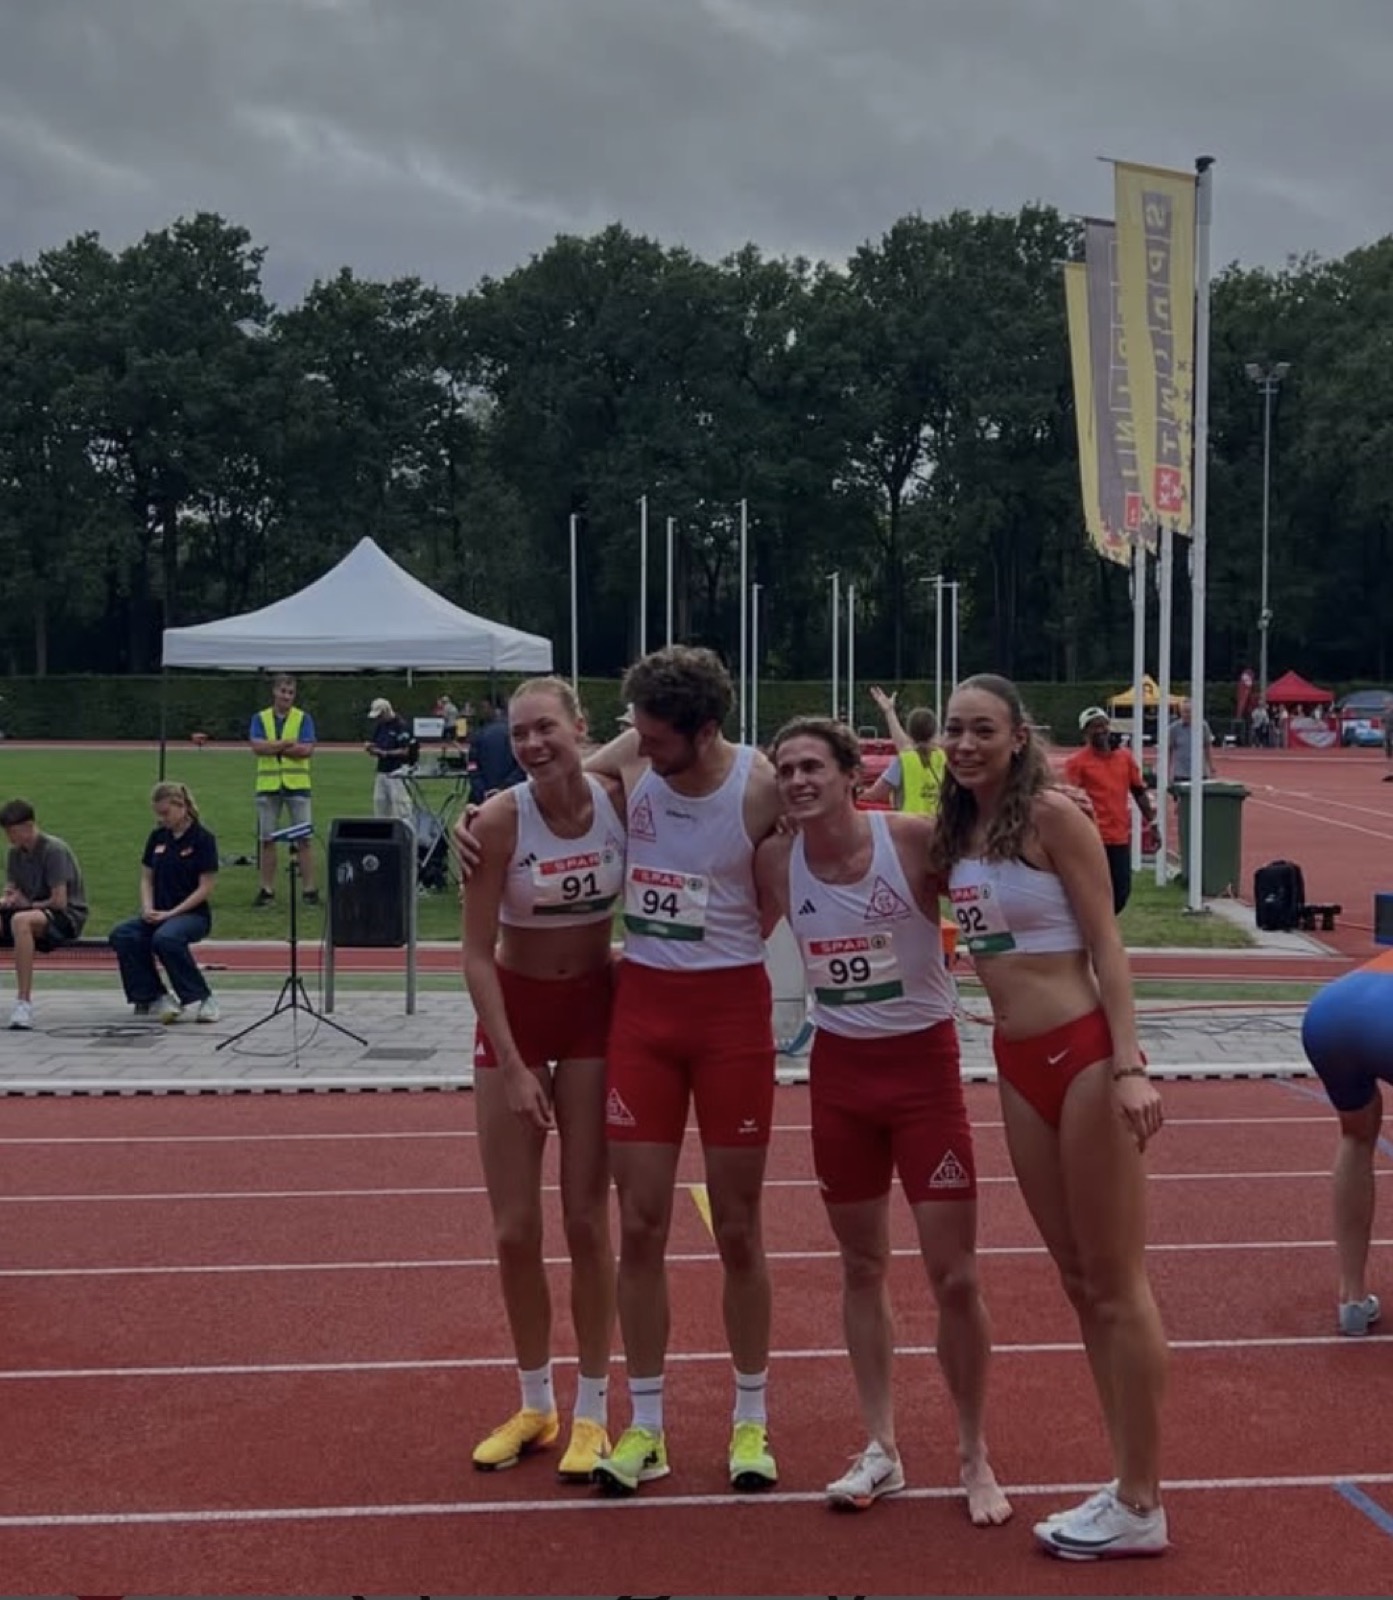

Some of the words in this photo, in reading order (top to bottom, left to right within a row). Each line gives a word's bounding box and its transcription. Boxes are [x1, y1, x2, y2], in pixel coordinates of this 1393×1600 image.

[554, 854, 600, 872] SPAR
[562, 873, 601, 900] 91
[641, 871, 684, 888] SPAR
[643, 890, 680, 917] 94
[957, 906, 987, 933] 92
[820, 937, 868, 954] SPAR
[830, 957, 870, 983] 99
